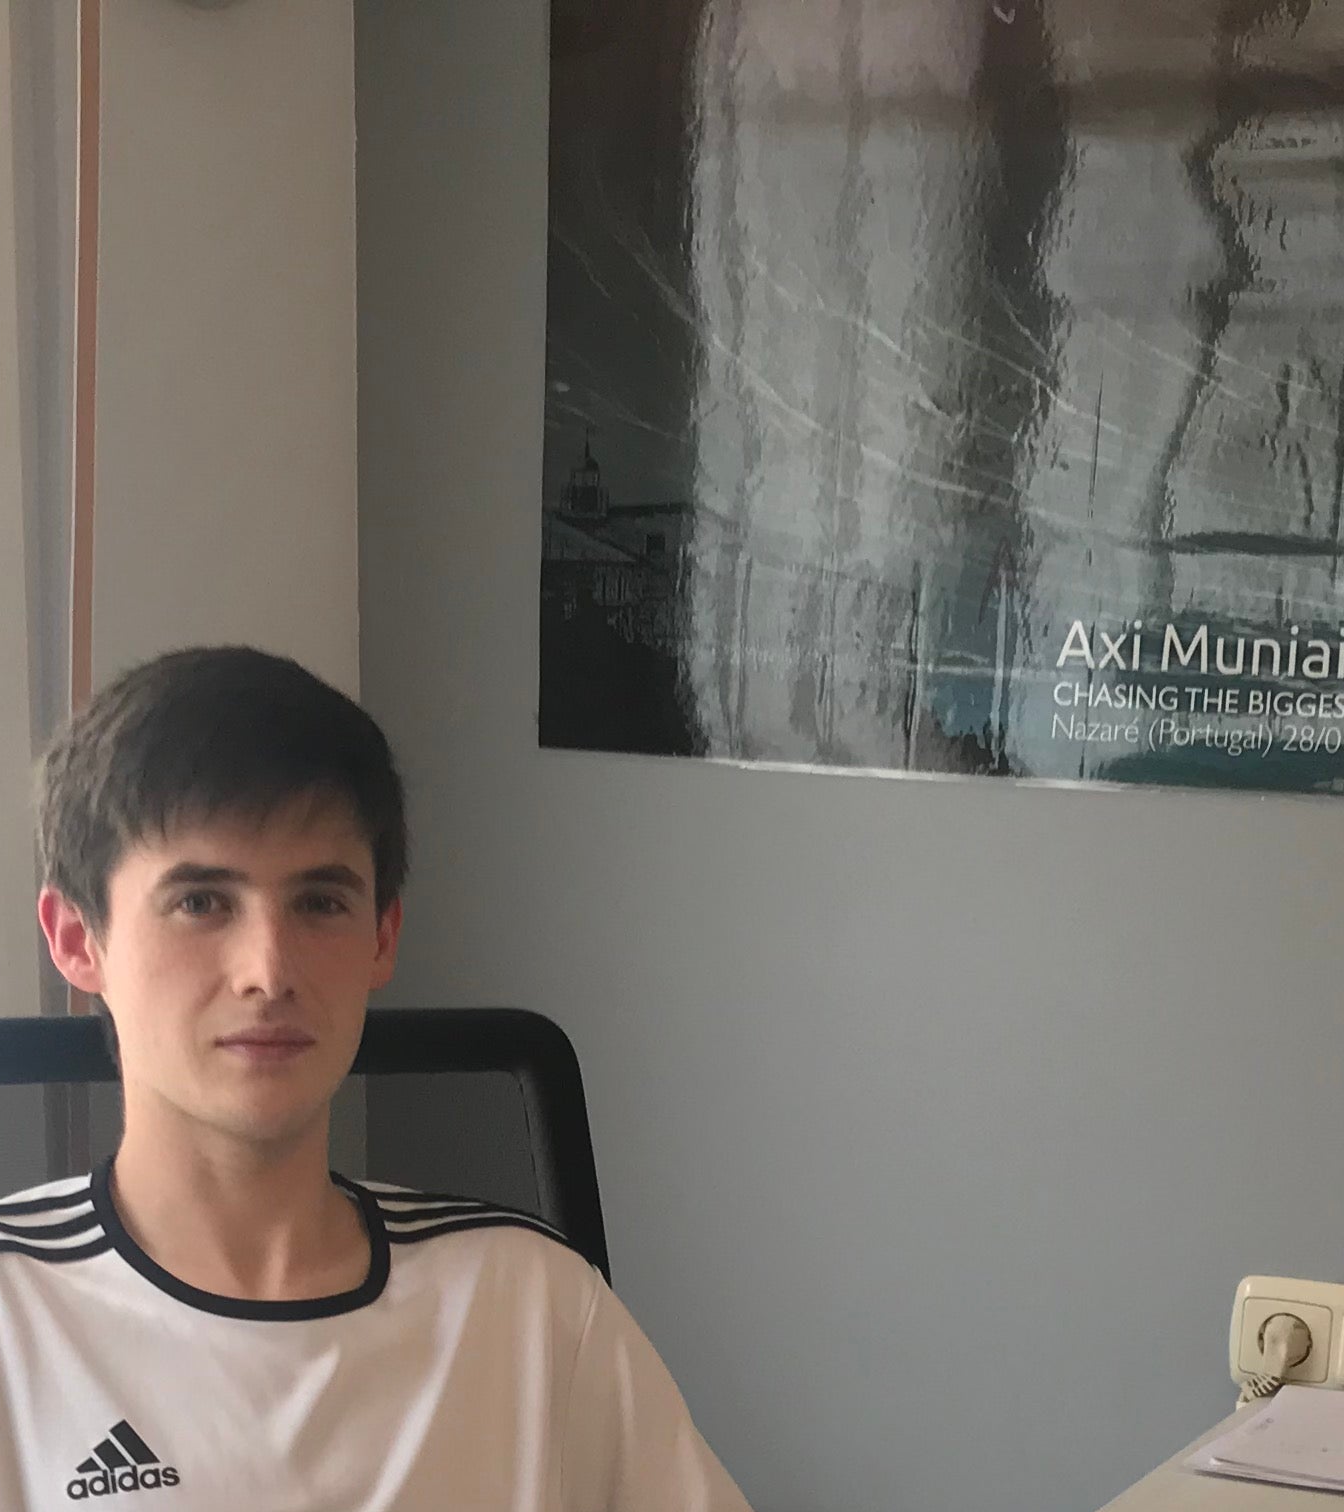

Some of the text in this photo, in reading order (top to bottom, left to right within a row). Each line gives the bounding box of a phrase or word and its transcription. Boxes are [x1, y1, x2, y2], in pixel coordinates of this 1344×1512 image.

[1056, 619, 1143, 672] Axi
[1053, 681, 1179, 711] CHASING
[1185, 687, 1240, 715] THE
[1051, 713, 1140, 744] Nazaré
[1148, 717, 1274, 758] (Portugal)
[67, 1465, 181, 1500] adidas
